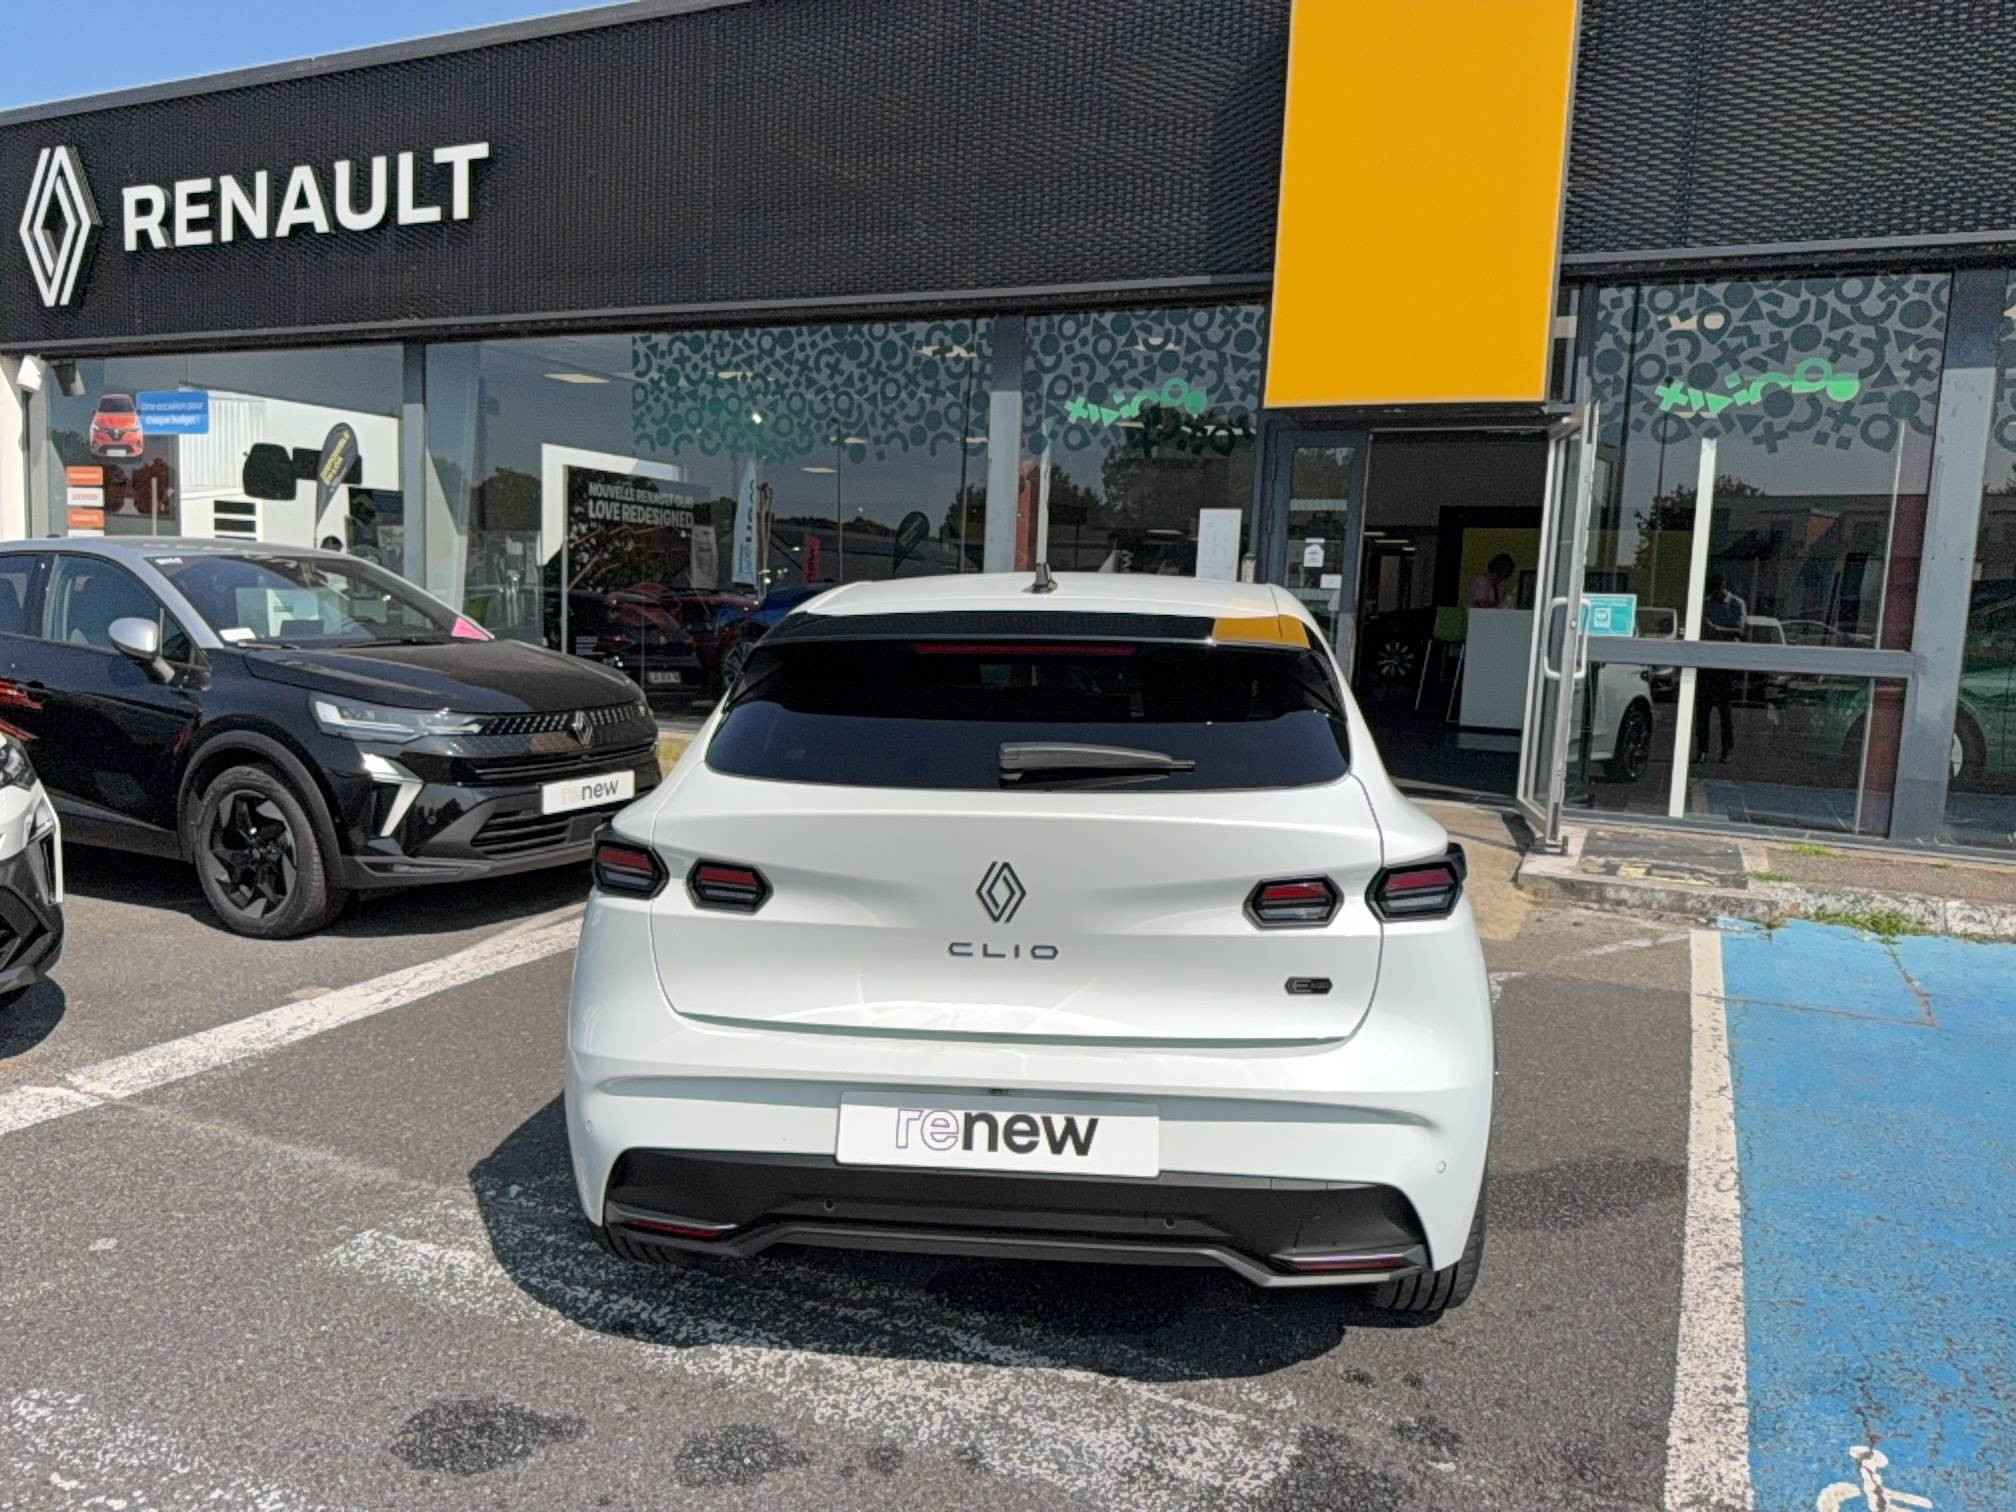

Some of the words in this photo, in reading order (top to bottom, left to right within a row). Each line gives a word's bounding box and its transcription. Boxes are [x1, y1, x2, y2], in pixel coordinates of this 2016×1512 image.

[122, 142, 490, 252] RENAULT
[588, 481, 635, 501] NOUVELLE
[588, 498, 621, 520] LOVE
[622, 503, 695, 529] REDESIGNED
[948, 942, 1059, 960] CLIO
[895, 1108, 1099, 1157] renew
